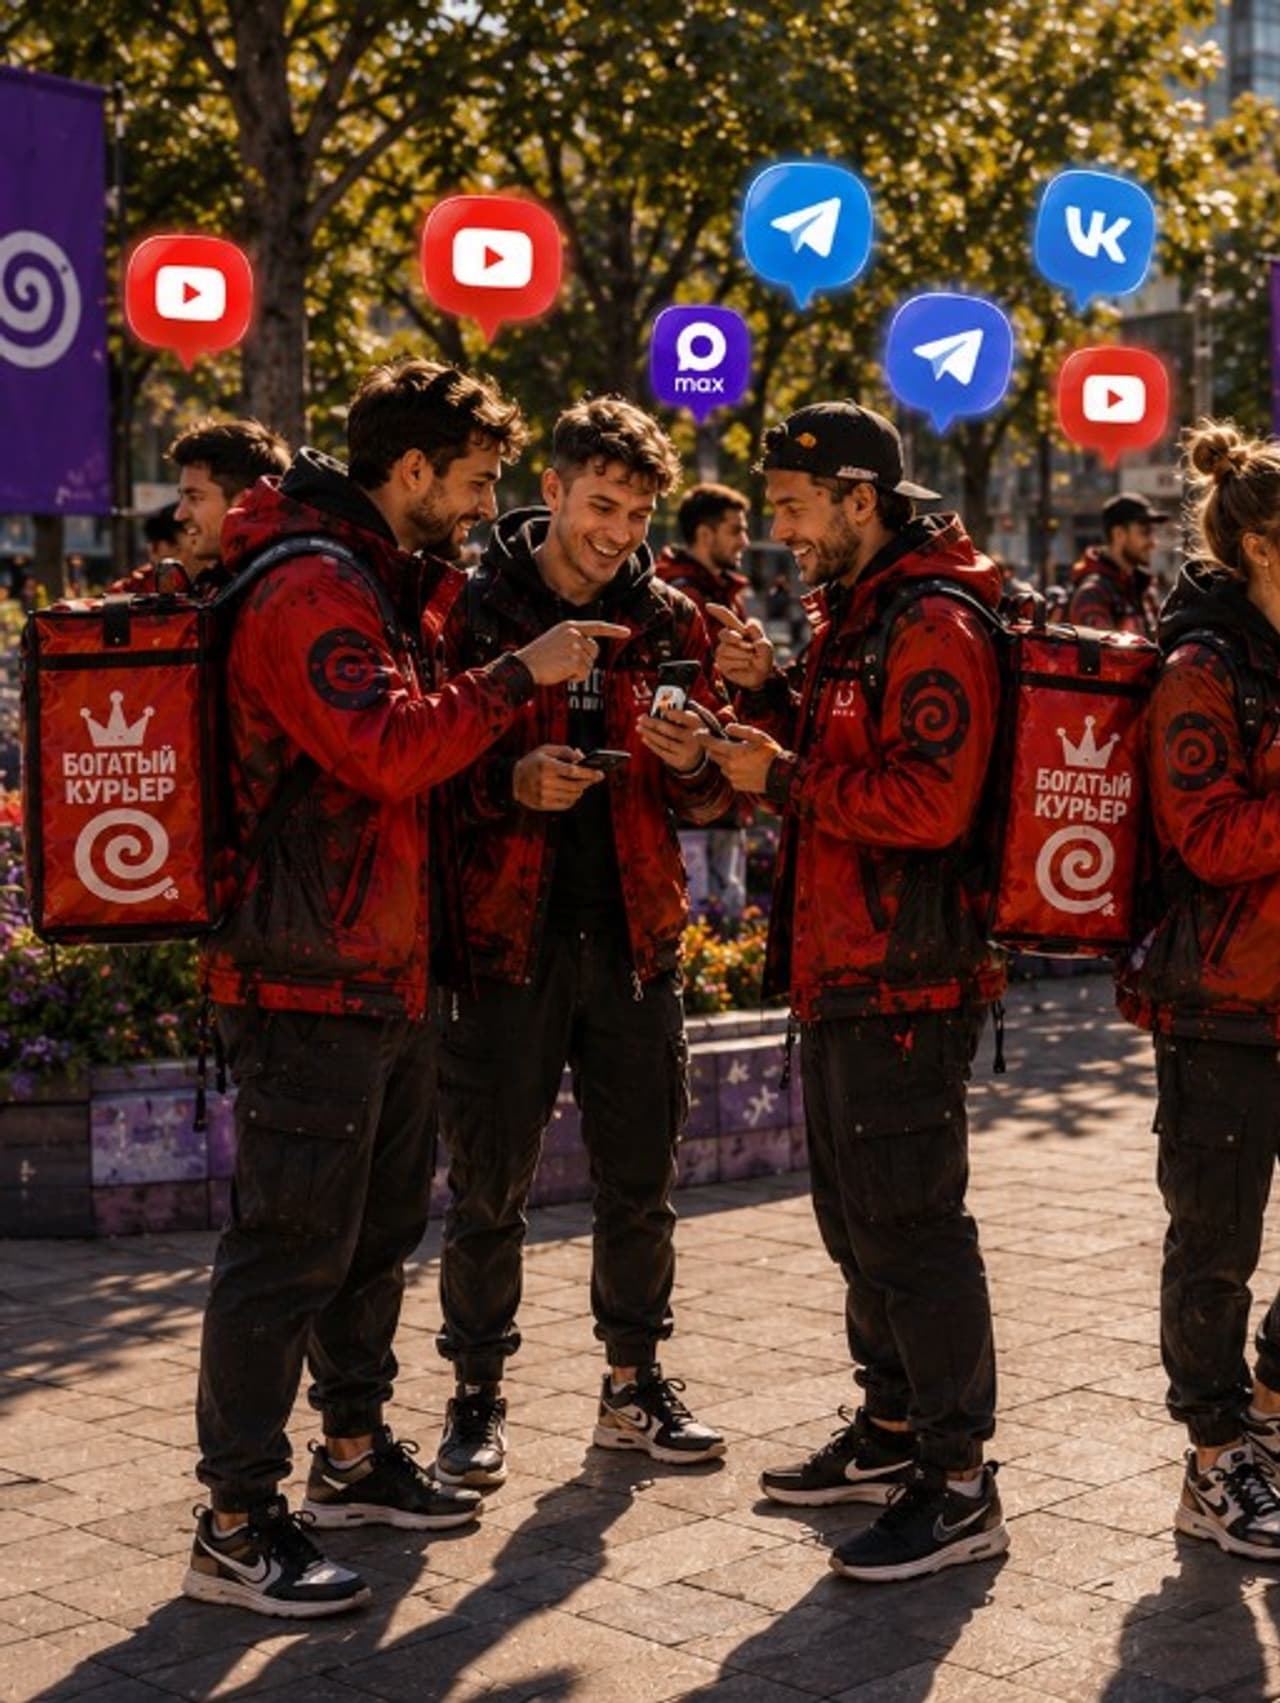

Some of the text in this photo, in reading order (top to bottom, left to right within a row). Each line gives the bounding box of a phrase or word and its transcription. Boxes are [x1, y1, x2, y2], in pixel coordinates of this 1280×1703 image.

[62, 744, 176, 777] БОГАТЫЙ
[65, 776, 175, 804] КУРЬЕР
[1035, 767, 1132, 798] БОГАТЫЙ
[1034, 793, 1127, 824] КУРЬЕР
